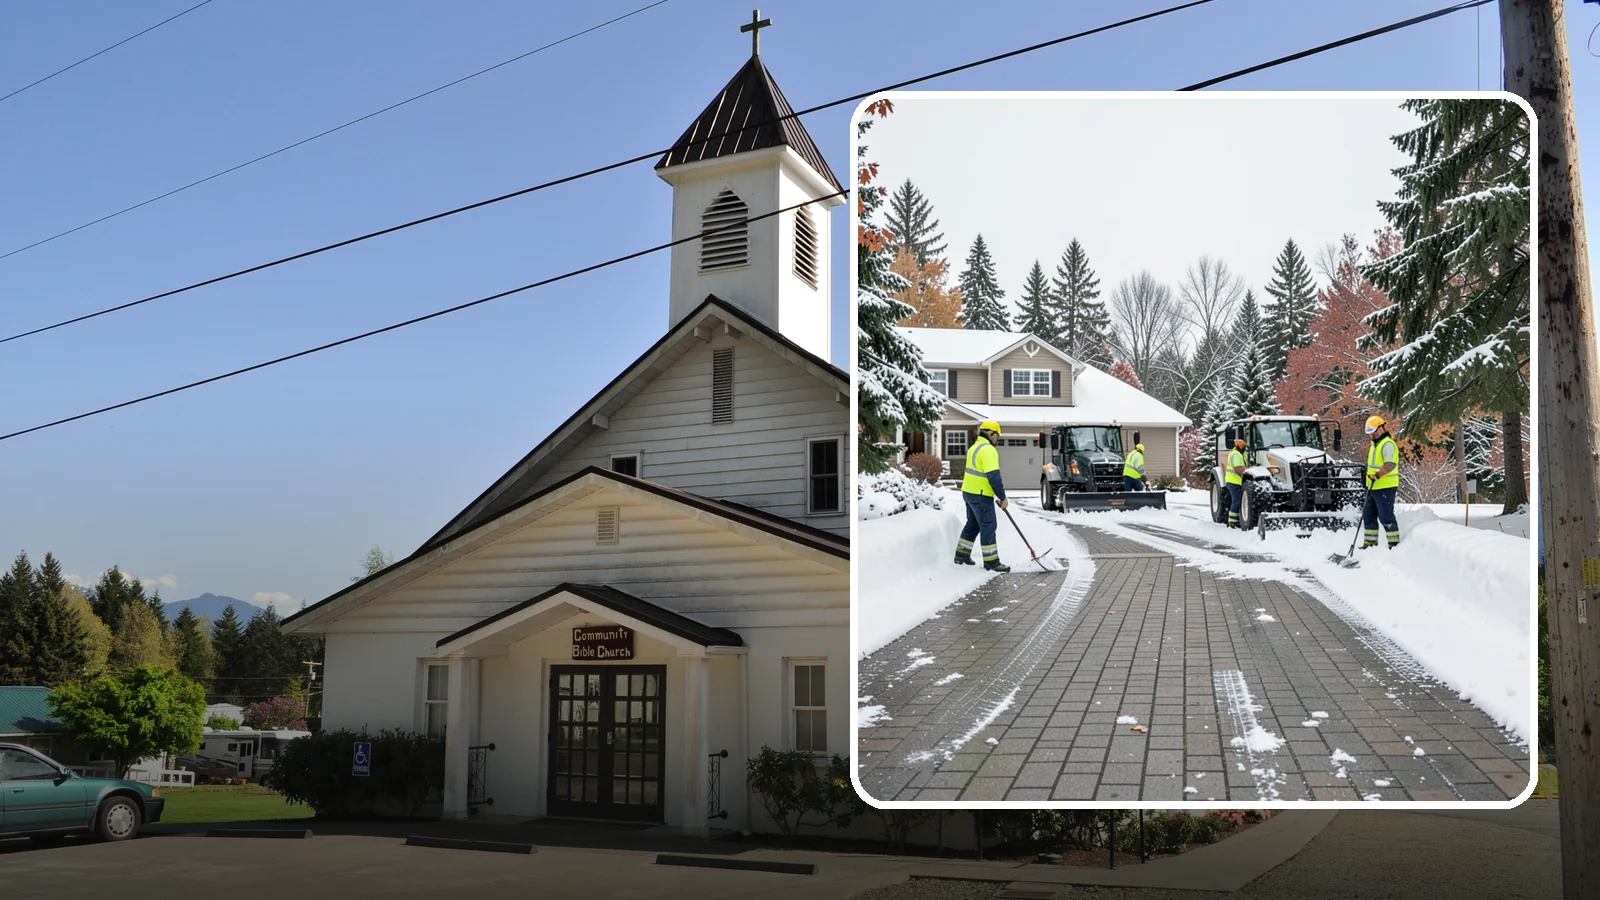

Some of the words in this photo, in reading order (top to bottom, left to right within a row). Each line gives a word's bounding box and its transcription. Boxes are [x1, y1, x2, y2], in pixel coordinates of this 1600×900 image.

[574, 627, 628, 641] Community
[572, 644, 595, 657] Bible
[597, 645, 631, 658] Church
